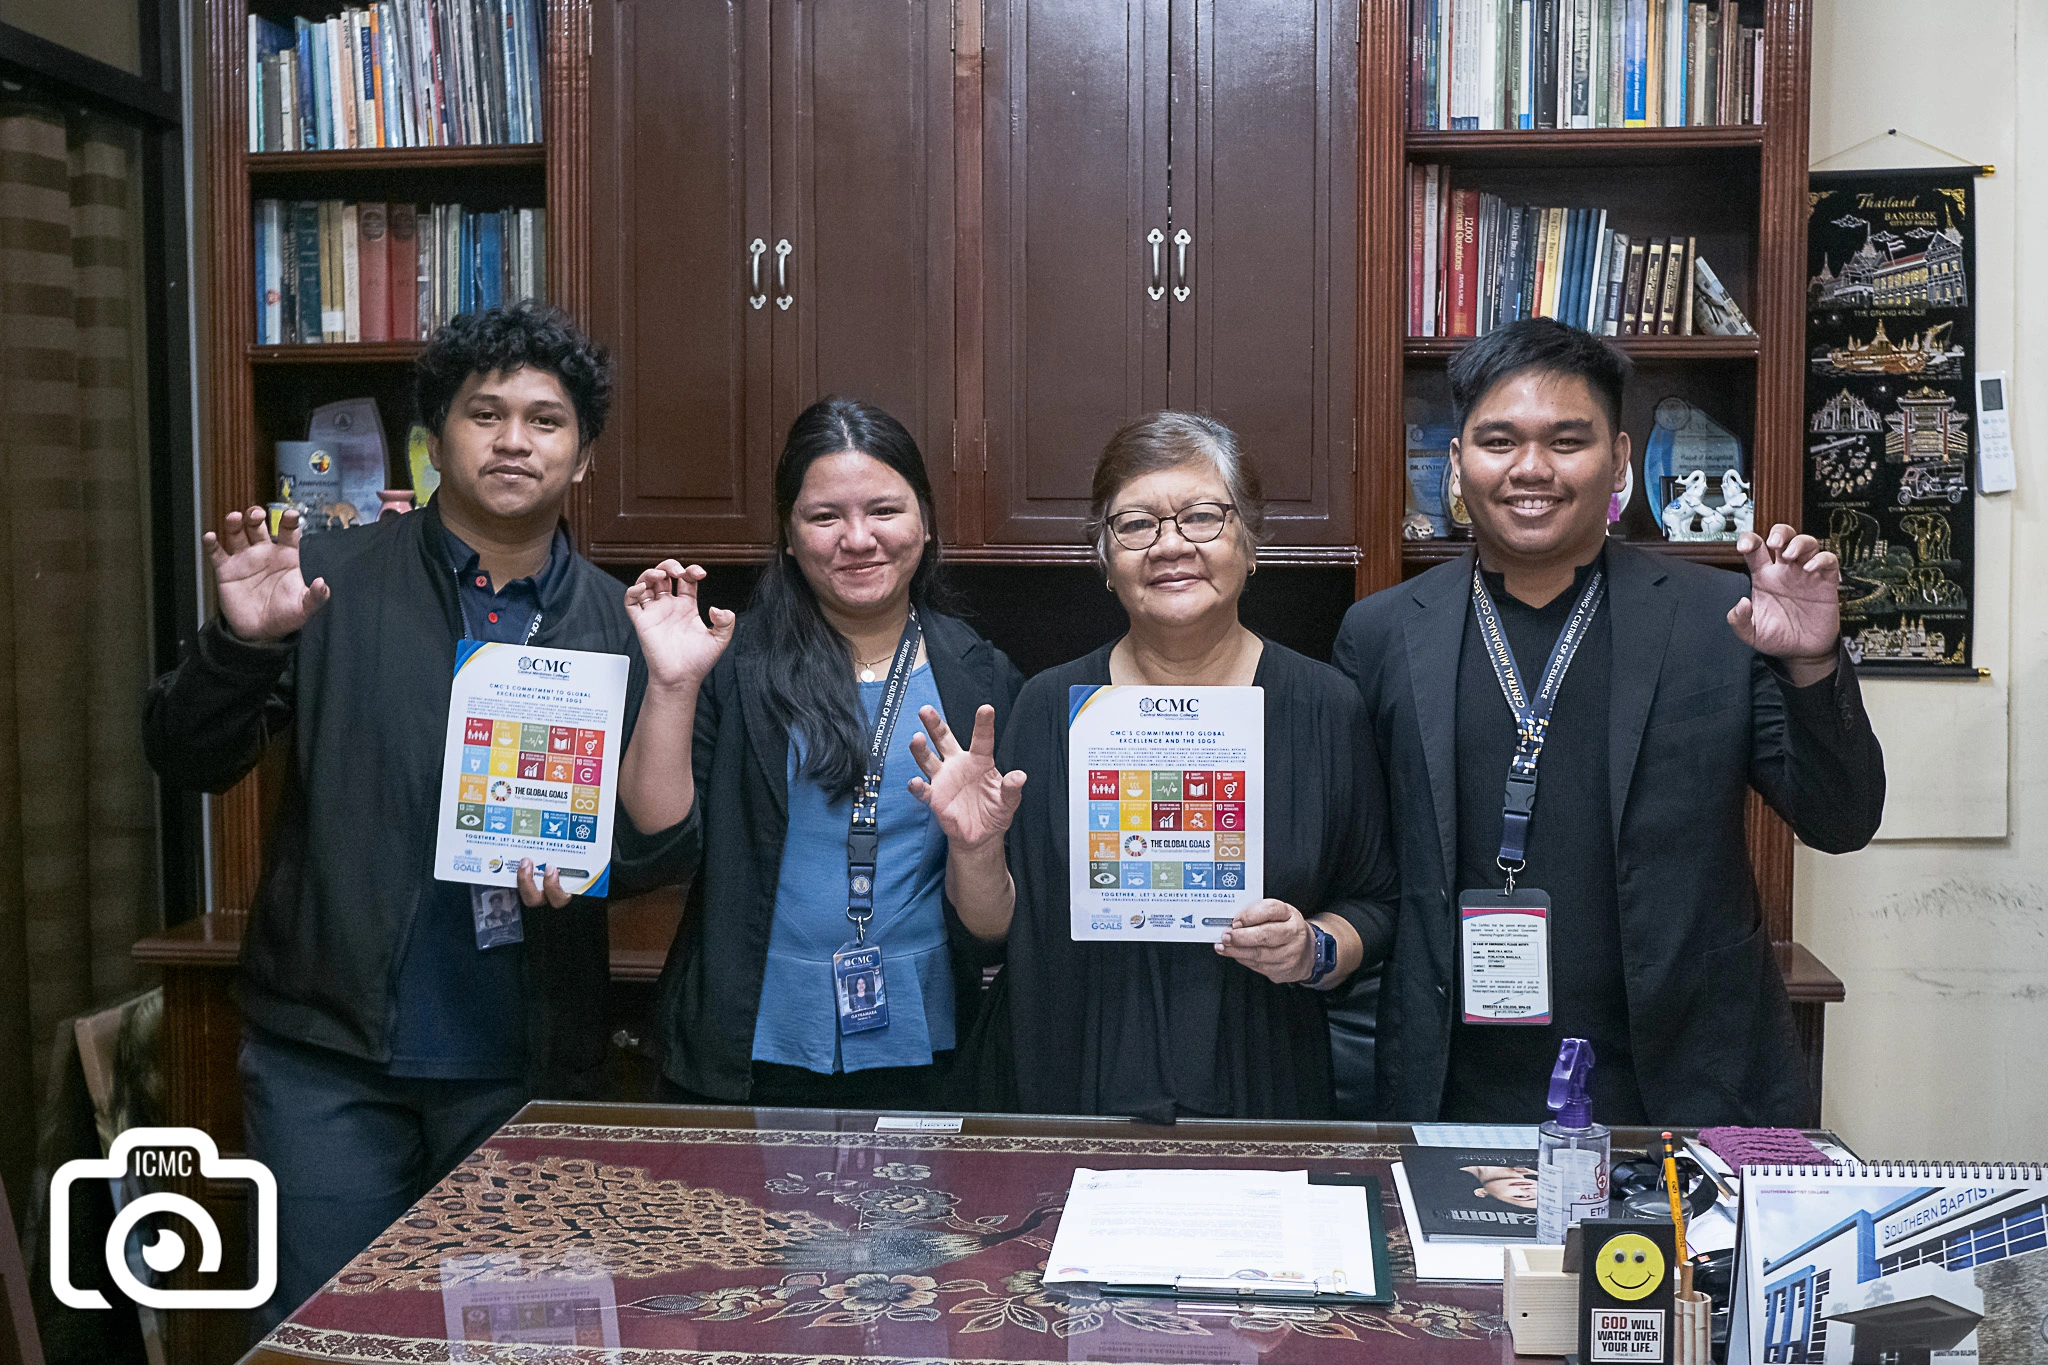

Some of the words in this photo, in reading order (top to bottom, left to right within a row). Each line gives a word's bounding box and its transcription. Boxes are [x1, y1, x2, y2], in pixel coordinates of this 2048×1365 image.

[1856, 193, 1920, 209] Thailand
[1885, 212, 1937, 220] BANGKOK
[1549, 225, 1557, 240] DAILY
[1454, 232, 1464, 271] Quotations
[1548, 242, 1556, 259] BREAD
[1581, 572, 1602, 609] NURTURING
[1564, 614, 1582, 644] CULTURE
[1486, 616, 1511, 666] MINDANAO
[895, 639, 911, 673] NURTURING
[1558, 643, 1569, 655] OF
[532, 658, 571, 673] CMC
[1540, 654, 1563, 699] EXCELLENCE
[497, 691, 535, 699] EXCELLENCE
[885, 679, 899, 709] CULTURE
[1504, 667, 1525, 709] CENTRAL
[1155, 698, 1199, 713] CMC
[883, 708, 890, 719] OF
[871, 718, 888, 757] EXCELLENCE
[515, 786, 525, 795] THE
[526, 787, 548, 797] GLOBAL
[549, 790, 568, 799] GOALS
[1151, 840, 1162, 848] THE
[1164, 840, 1187, 848] GLOBAL
[1189, 840, 1210, 848] GOALS
[454, 864, 481, 872] GOALS
[851, 954, 872, 965] CMC
[1450, 1210, 1537, 1225] &Hom
[1885, 1205, 1938, 1240] SOUTHERN
[1602, 1316, 1627, 1329] GOD
[1631, 1320, 1655, 1329] WILL
[1597, 1331, 1631, 1340] WATCH
[1634, 1332, 1658, 1341] OVER
[1602, 1342, 1627, 1352] YOUR
[1631, 1343, 1653, 1352] LIFE.
